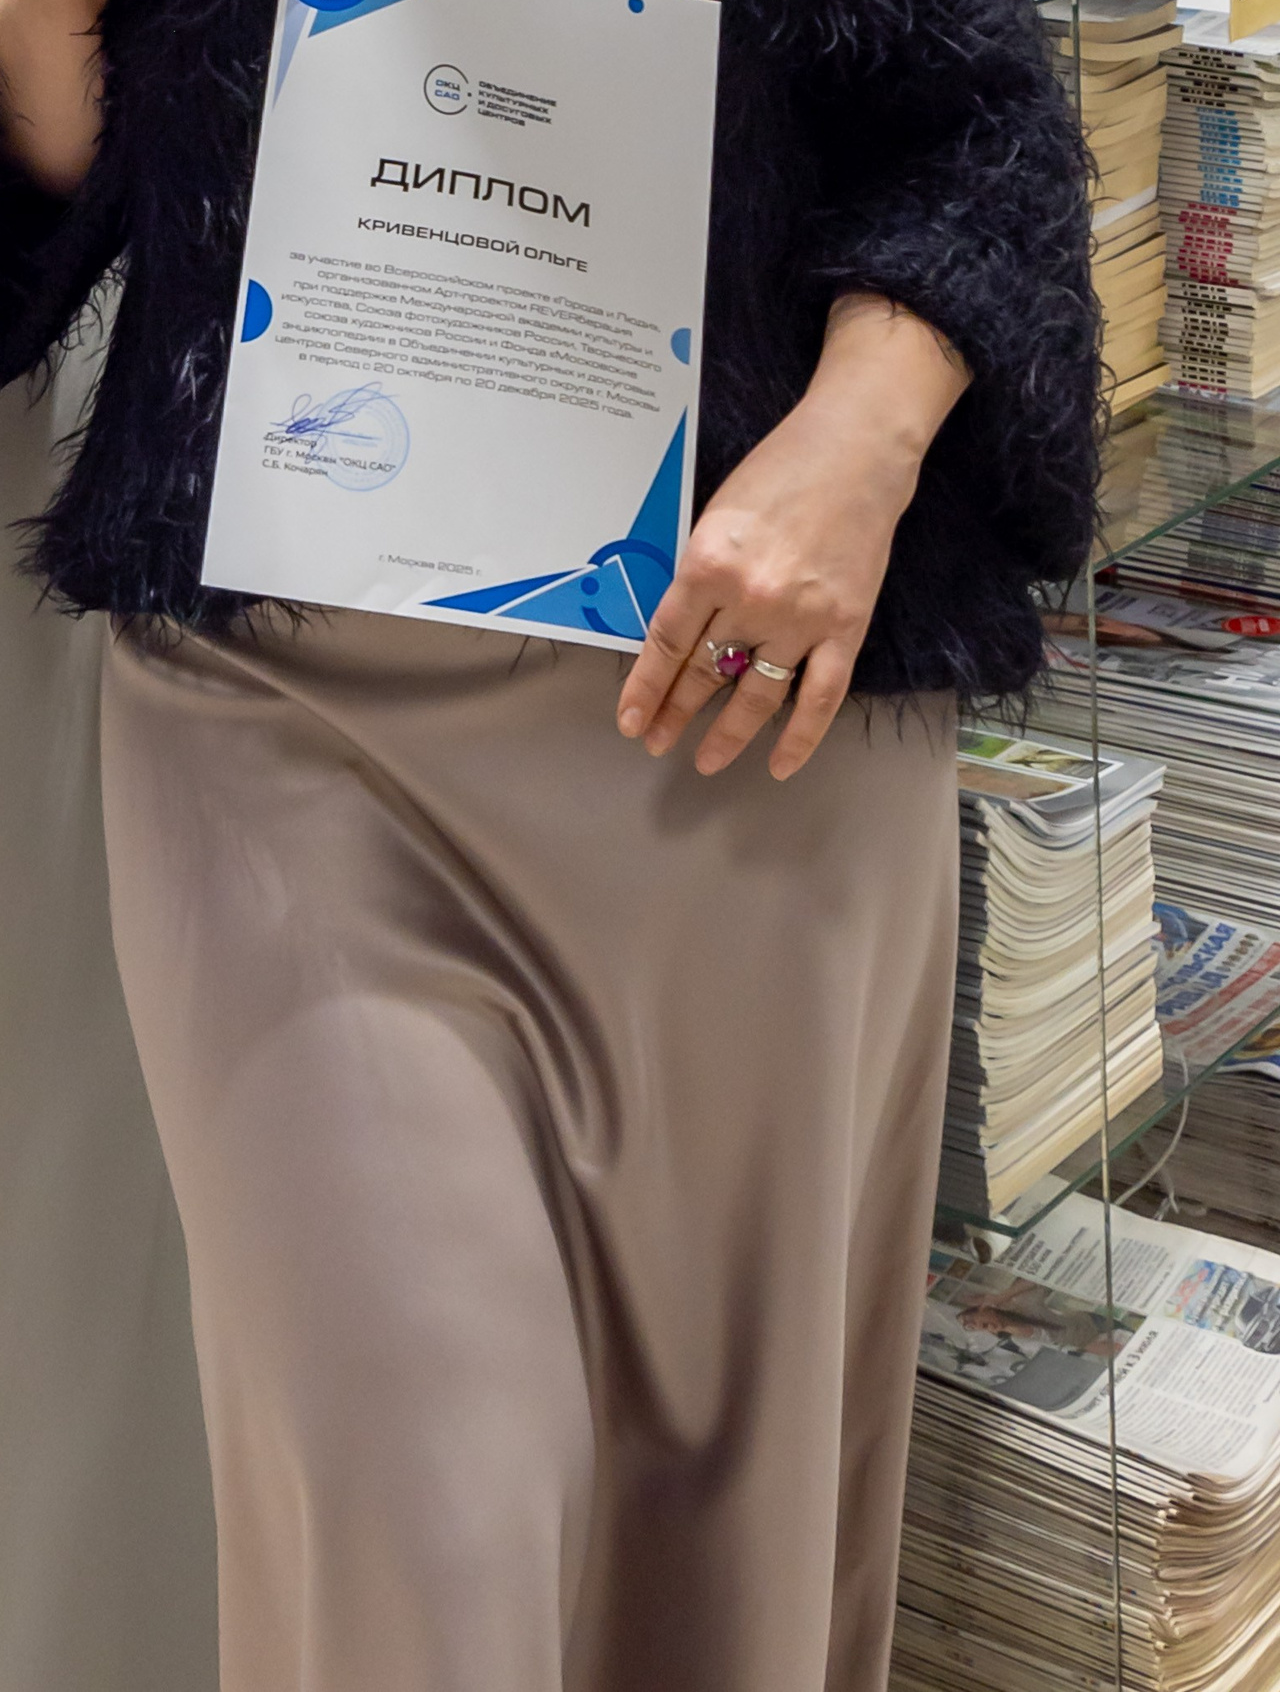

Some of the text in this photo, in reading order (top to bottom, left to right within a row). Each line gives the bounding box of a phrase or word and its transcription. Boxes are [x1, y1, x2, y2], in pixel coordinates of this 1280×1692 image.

[434, 89, 460, 101] САО
[435, 79, 460, 91] ОКЦ
[477, 108, 525, 126] ЦЕНТРОВ
[370, 158, 591, 228] ДИПЛОМ
[357, 216, 588, 273] КРИВЕНЦОВОЙ ОЛЬГЕ
[289, 251, 306, 261] за
[308, 253, 362, 269] участие
[365, 263, 382, 273] во
[384, 264, 494, 291] Всероссийском
[496, 283, 551, 302] проекте
[553, 296, 604, 317] «Города
[606, 309, 614, 318] и
[293, 280, 653, 356] при поддержке Международной академии культуры и
[317, 269, 633, 337] организованном Арт-проектом REVERберация
[280, 292, 353, 311] искусства,
[355, 302, 402, 319] Союза
[404, 311, 522, 338] фотохудожников
[581, 342, 662, 373] Творческого
[282, 321, 656, 398] энциклопедии» в Объединении культурных и досуговых
[304, 310, 638, 379] союза художников России и Фонда «Московские
[275, 334, 331, 350] центров
[334, 341, 408, 362] Северного
[411, 355, 547, 386] административного
[550, 378, 594, 395] округа
[606, 390, 661, 413] Москвы
[299, 352, 634, 420] в период с 20 октября по 20 декабря 2025 года.
[262, 458, 329, 477] С.Б. Кочарян
[263, 432, 317, 449] Директор
[263, 445, 283, 456] ГБУ
[295, 450, 337, 464] Москвы
[339, 457, 368, 470] "ОКЦ
[368, 461, 396, 473] САО"
[387, 554, 435, 569] Москва
[437, 561, 474, 576] 2025
